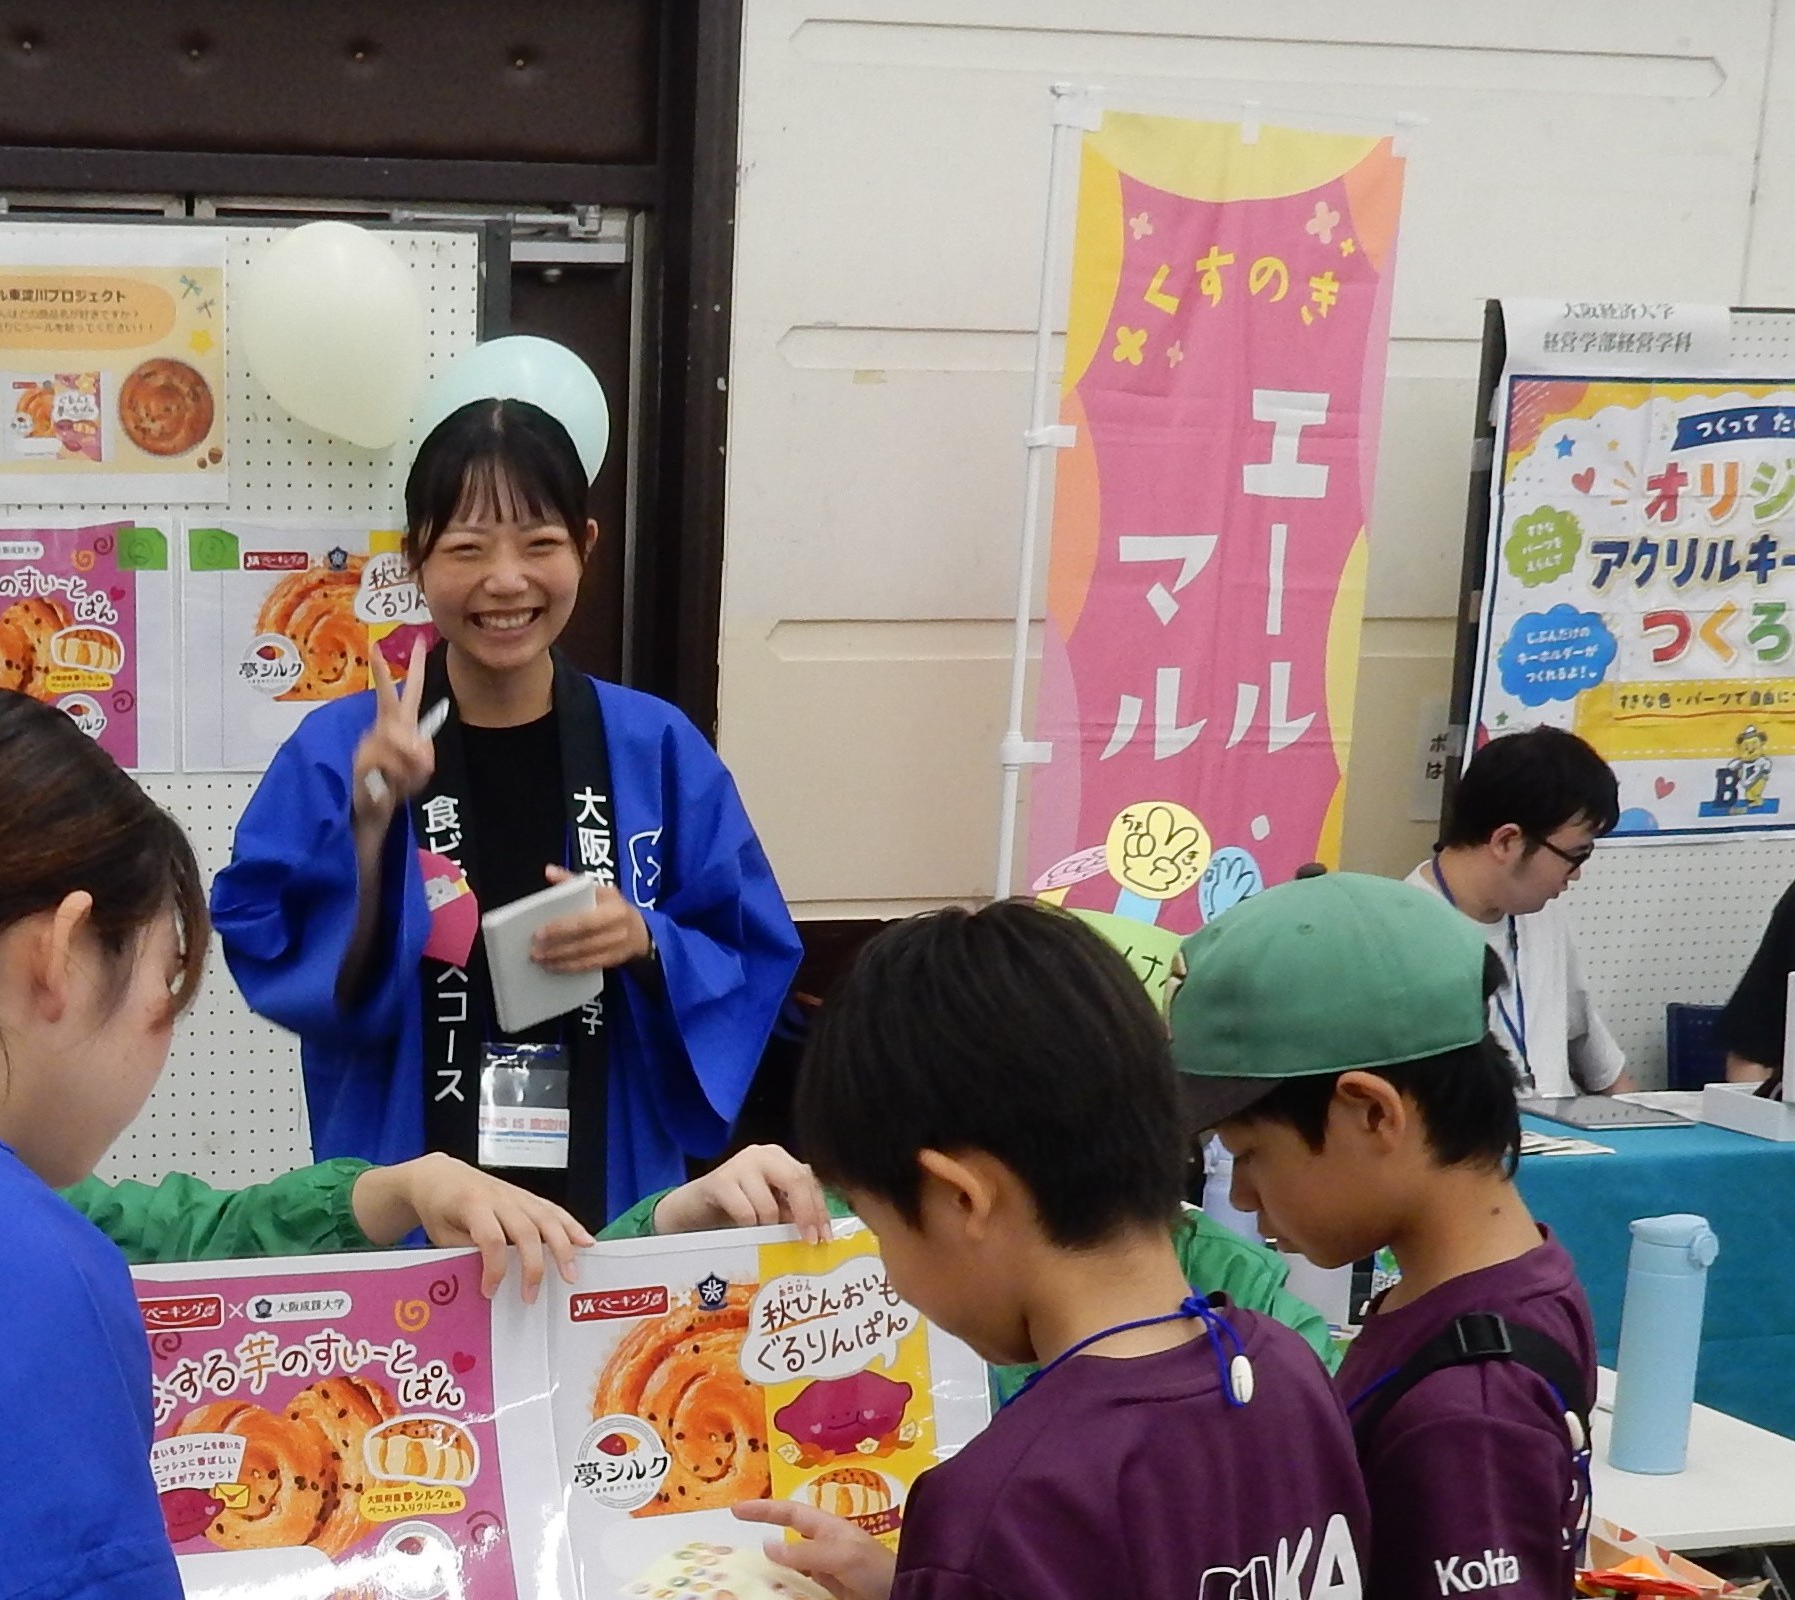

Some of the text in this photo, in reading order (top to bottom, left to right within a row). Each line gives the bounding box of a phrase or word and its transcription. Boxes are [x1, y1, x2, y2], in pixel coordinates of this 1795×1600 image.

[1144, 245, 1340, 326] くすのき
[1695, 414, 1760, 438] つくって
[1225, 388, 1332, 756] エール
[76, 595, 116, 622] ぱん
[1642, 600, 1792, 663] つくろ
[1098, 533, 1220, 762] マル
[756, 1311, 909, 1373] ぐるりんぱん
[403, 1364, 462, 1407] ぱん
[573, 1456, 668, 1489] 夢シルク
